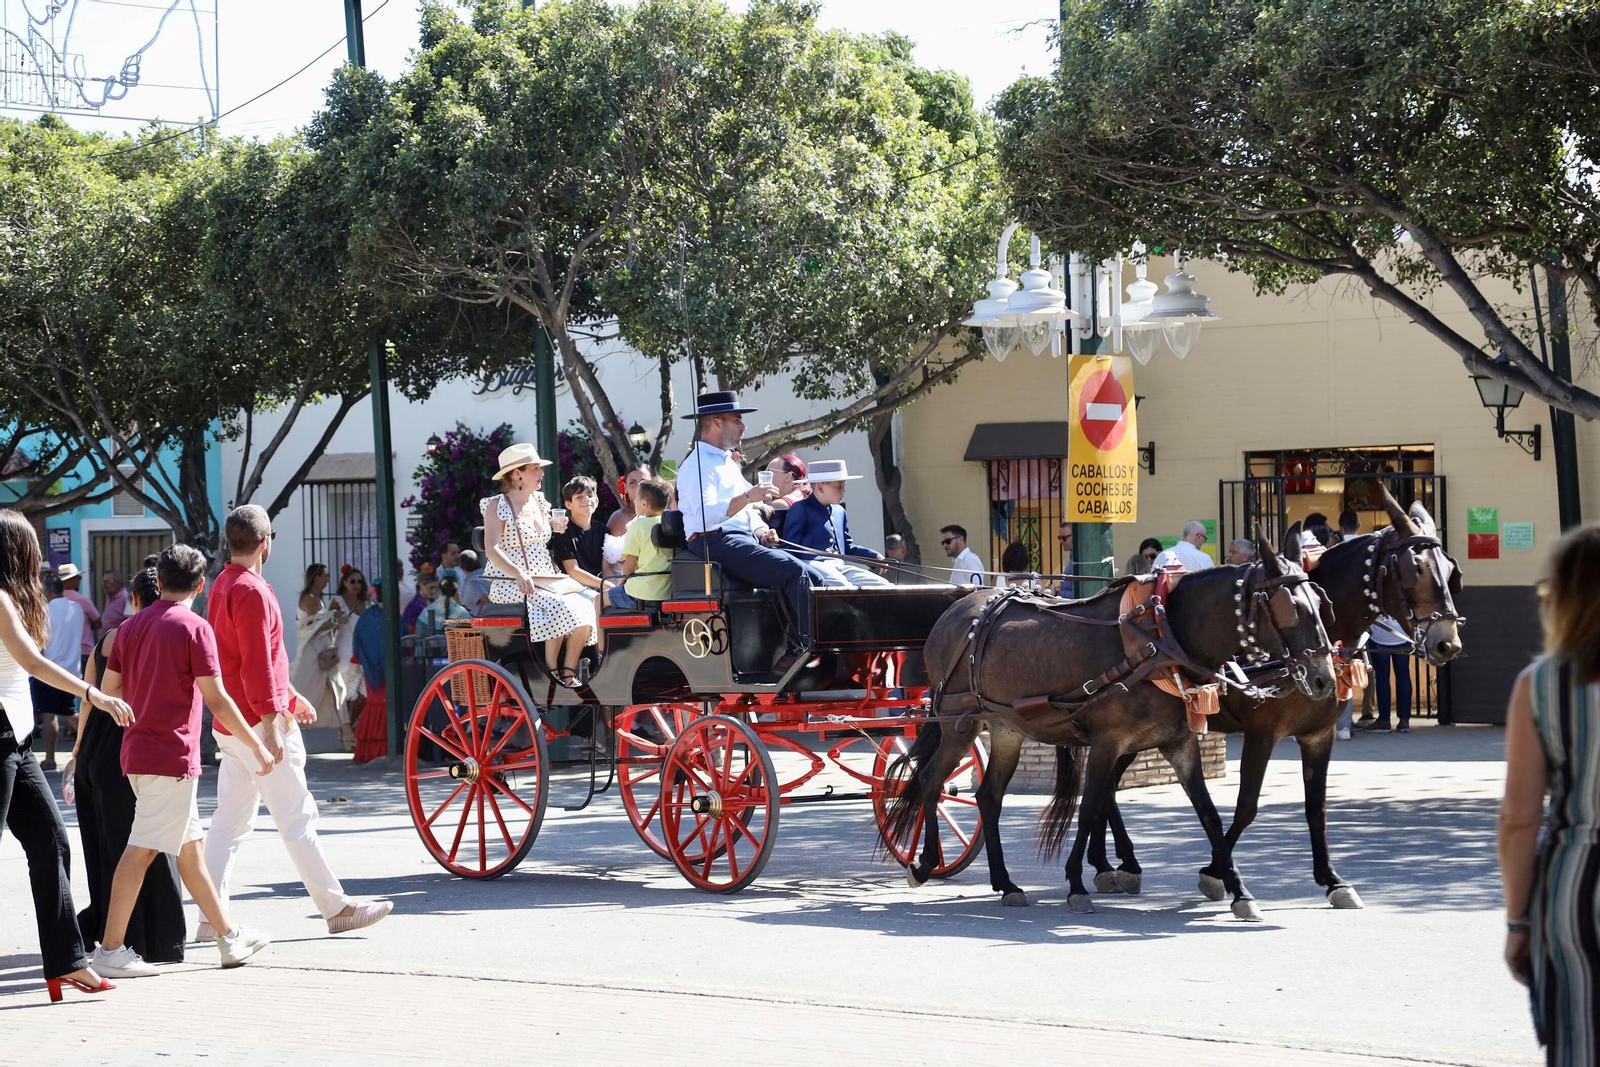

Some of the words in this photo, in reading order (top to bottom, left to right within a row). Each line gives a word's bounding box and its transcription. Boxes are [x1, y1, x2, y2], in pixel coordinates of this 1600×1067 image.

[1071, 464, 1127, 478] CABALLOS
[1129, 465, 1135, 479] Y
[1076, 482, 1120, 496] COCHES
[1122, 483, 1133, 496] DE
[1077, 500, 1132, 514] CABALLOS
